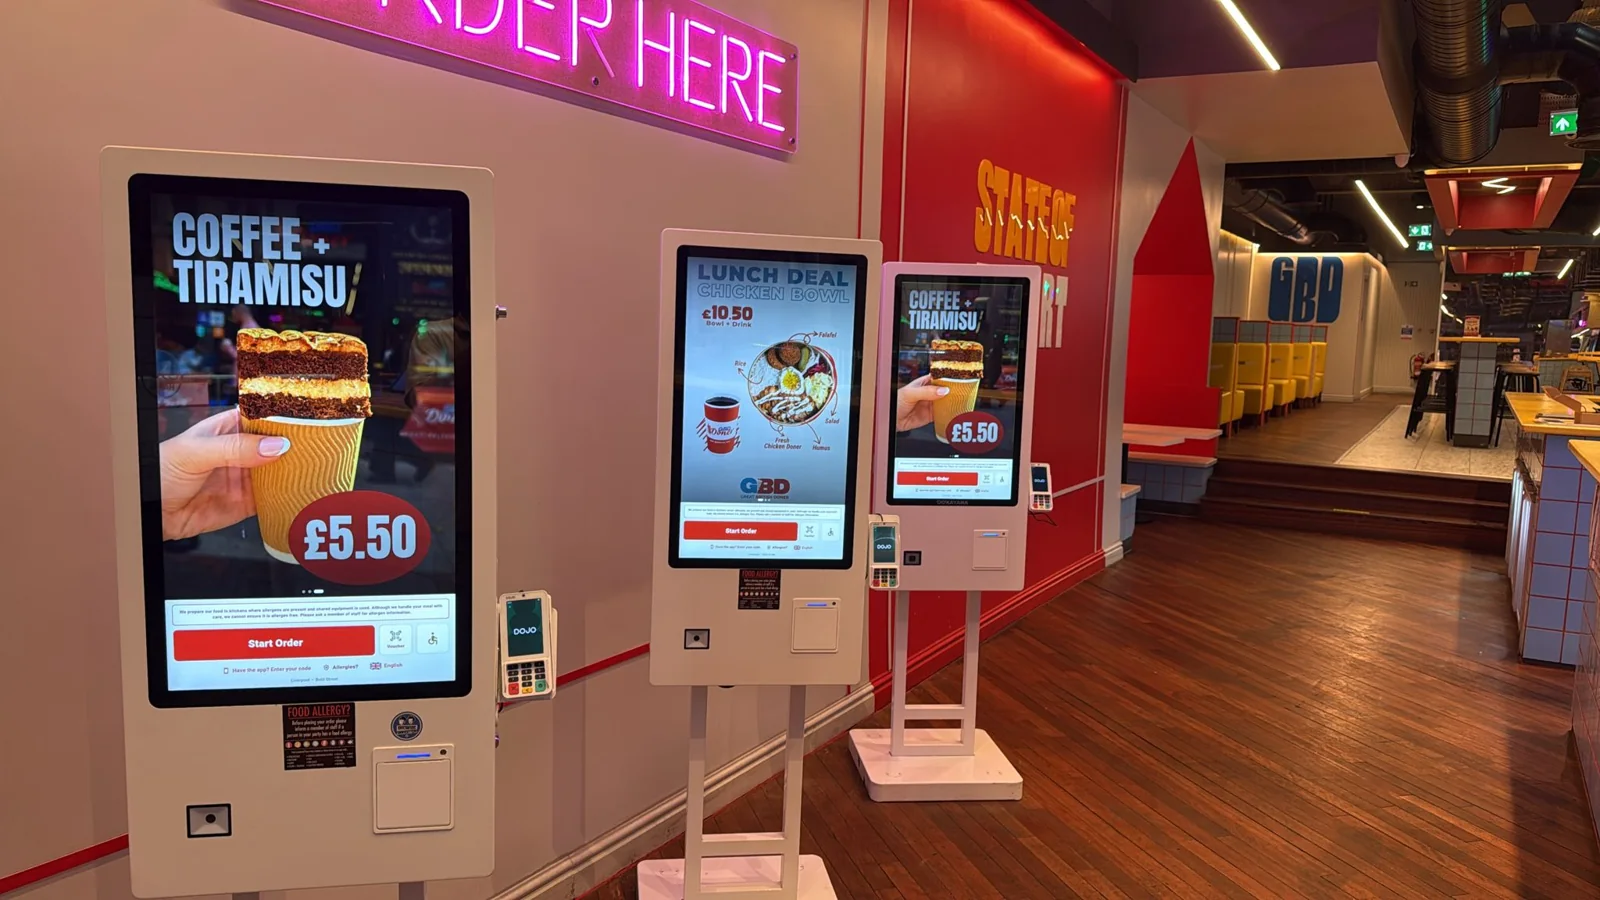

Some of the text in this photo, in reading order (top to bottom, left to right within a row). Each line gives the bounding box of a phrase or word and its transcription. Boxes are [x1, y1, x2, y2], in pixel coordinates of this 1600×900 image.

[637, 0, 786, 132] HERE
[172, 212, 301, 260] COFFEE
[173, 259, 347, 309] TIRAMISU
[697, 264, 849, 287] LUNCH DEAL
[696, 282, 850, 304] CHICKEN BOWL
[909, 290, 960, 310] COFFEE
[1268, 256, 1344, 323] GBD
[702, 304, 754, 321] £10.50
[908, 310, 978, 331] TIRAMISU
[951, 422, 999, 443] £5.50
[740, 478, 790, 494] GBD
[304, 514, 417, 560] £5.50
[513, 626, 537, 635] DOJO
[248, 638, 304, 648] Start Order
[288, 704, 351, 718] FOOD ALLERGY?
